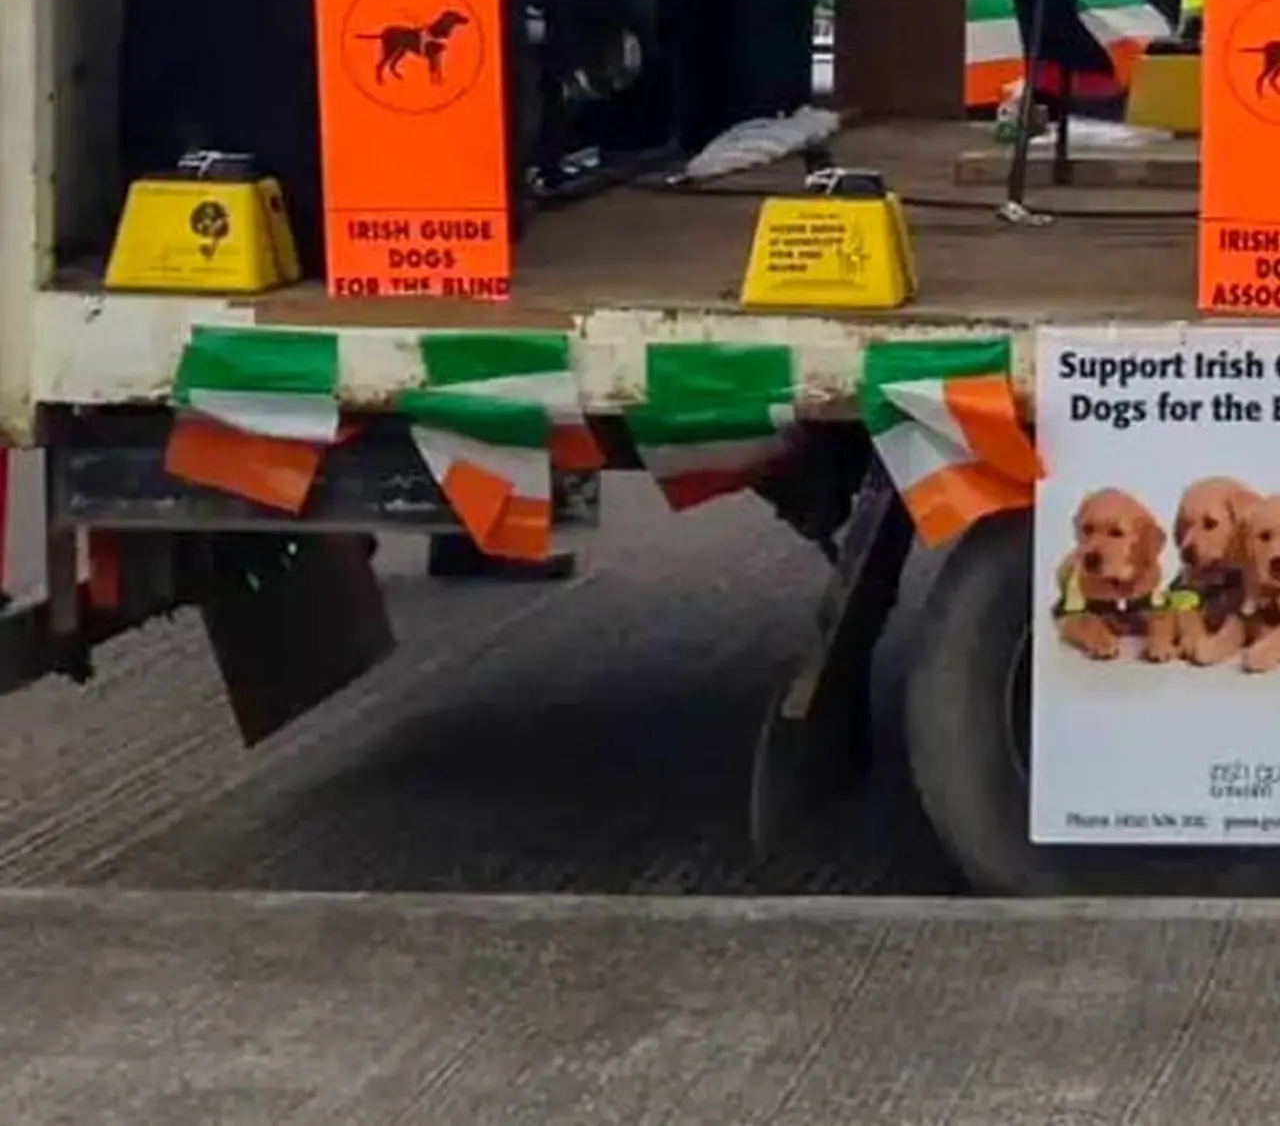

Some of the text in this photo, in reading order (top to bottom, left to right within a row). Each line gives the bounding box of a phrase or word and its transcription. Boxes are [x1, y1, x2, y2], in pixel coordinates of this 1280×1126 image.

[348, 219, 494, 241] IRISH GUIDE
[1219, 228, 1280, 253] IRISH
[388, 247, 457, 269] DOGS
[442, 276, 511, 297] BLIND
[1058, 350, 1186, 388] Support
[1194, 350, 1264, 379] Irish
[1070, 393, 1148, 429] Dogs
[1157, 390, 1202, 422] for
[1211, 392, 1262, 422] the
